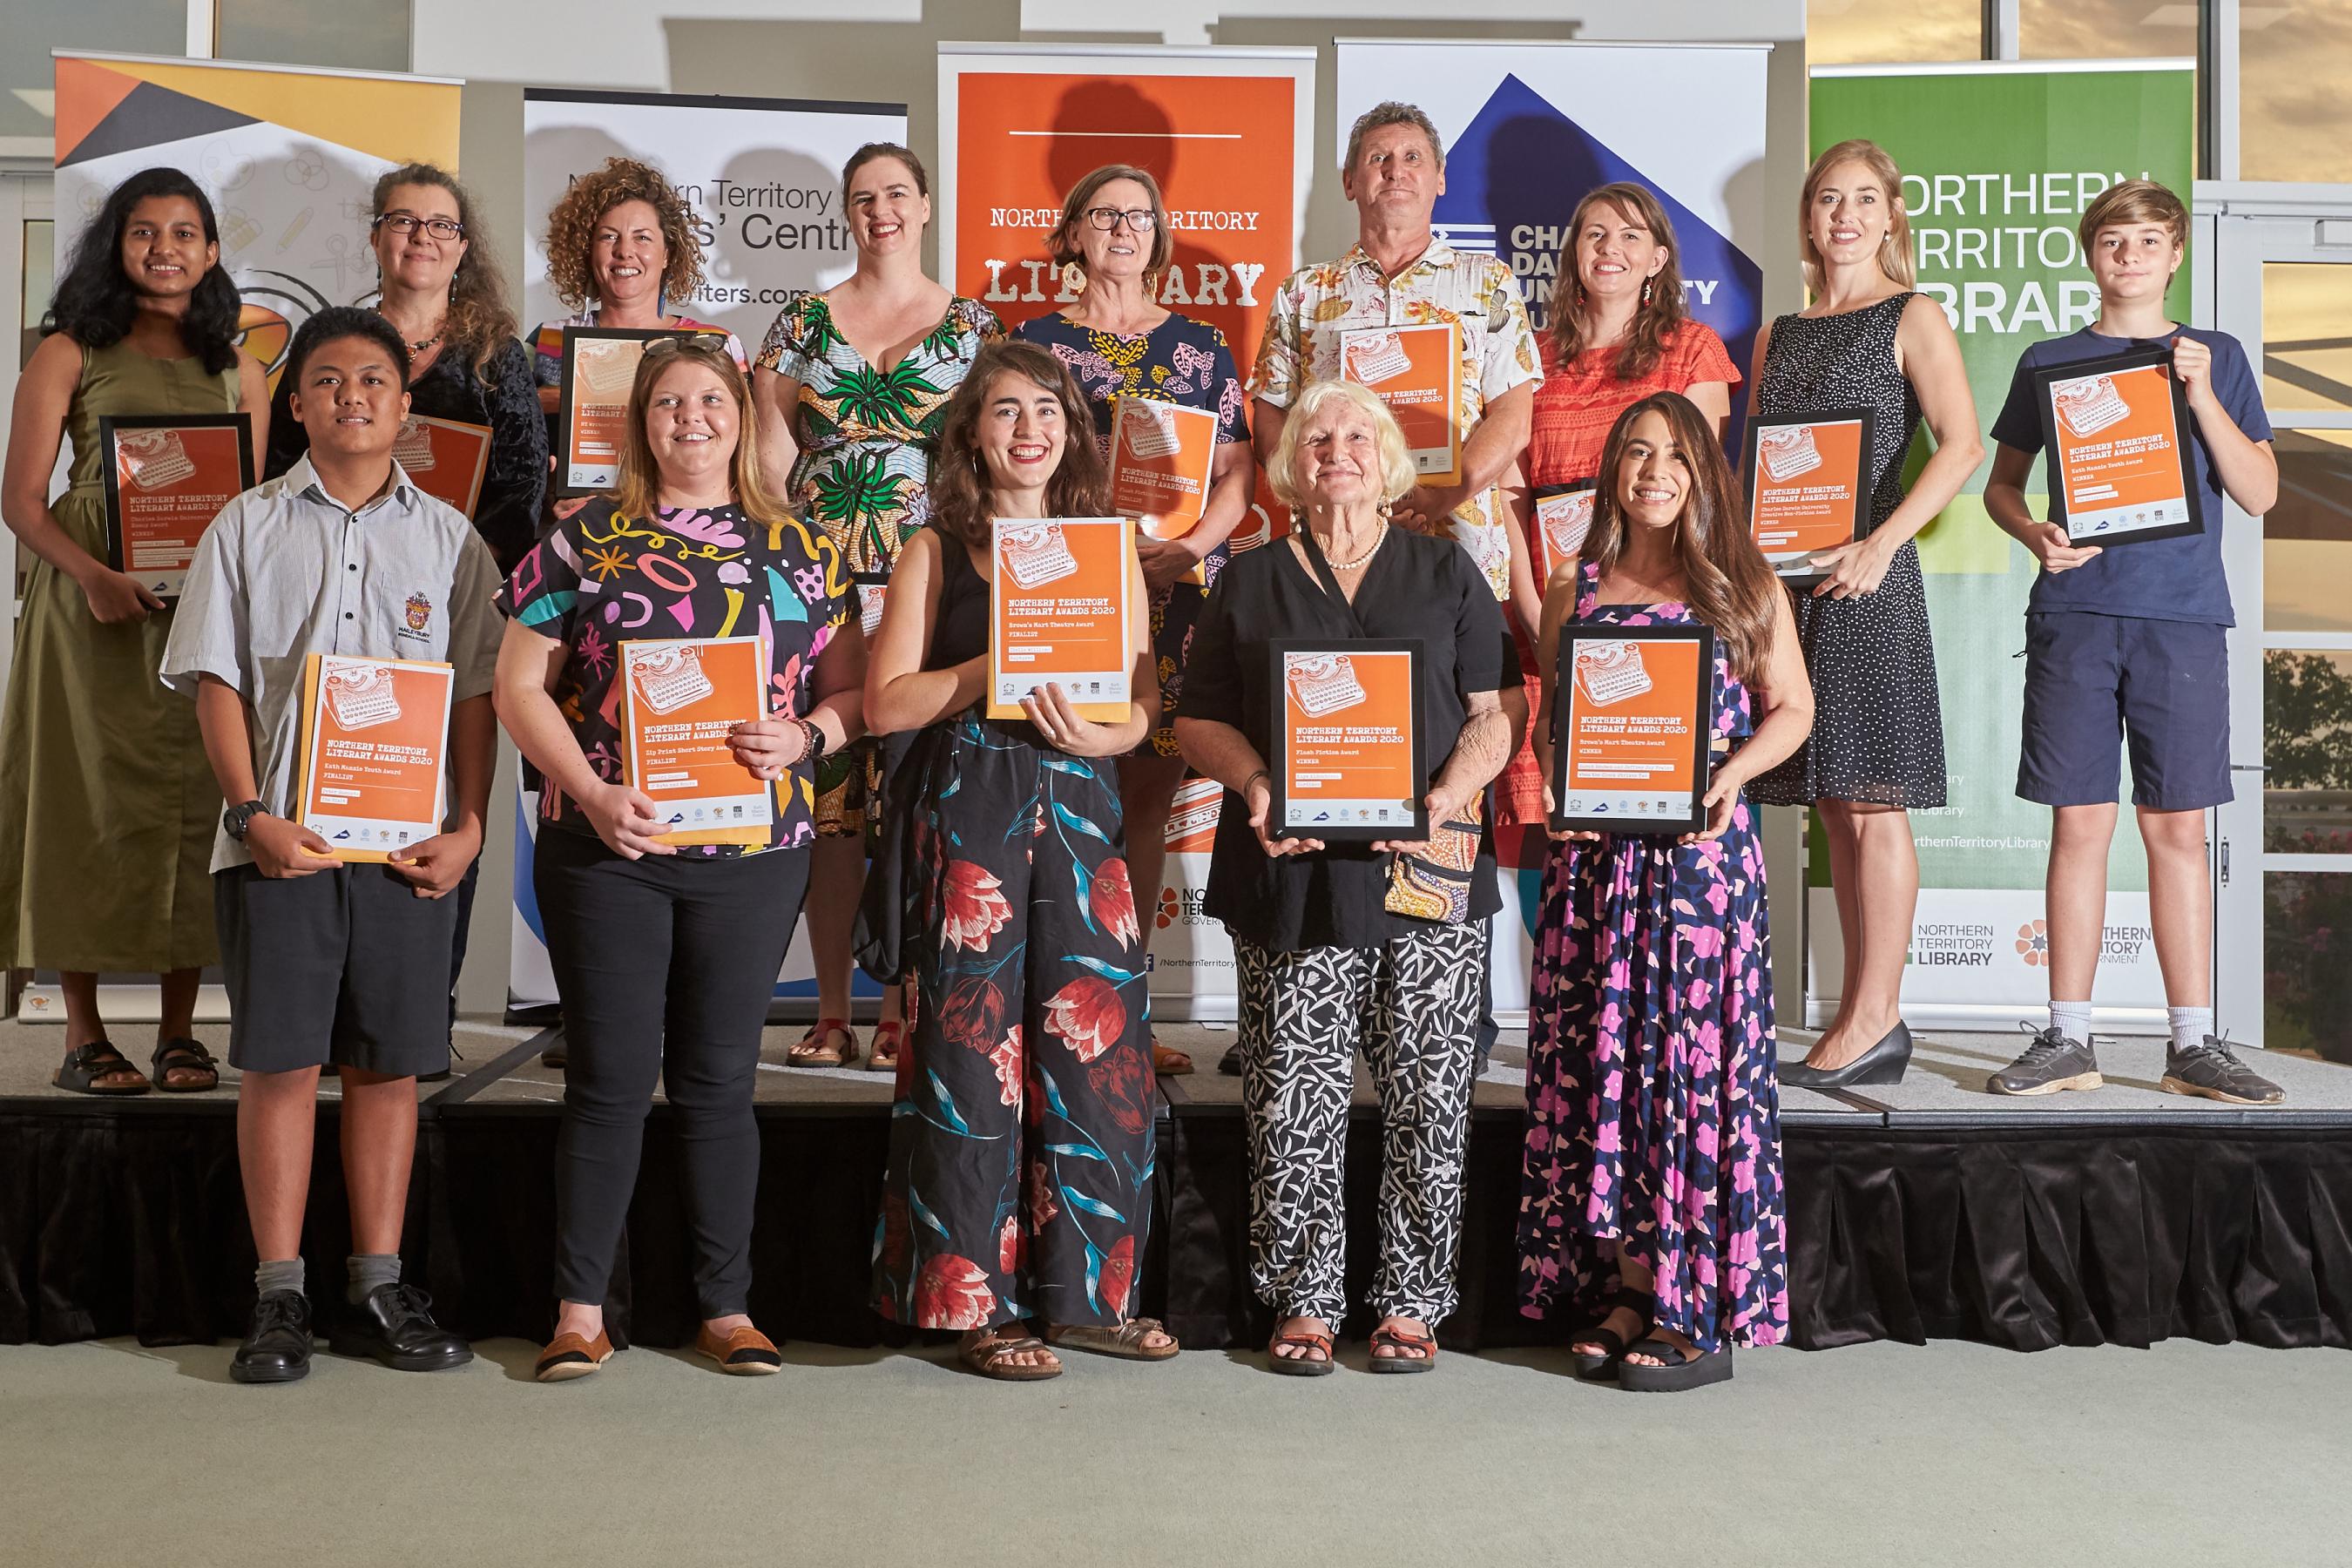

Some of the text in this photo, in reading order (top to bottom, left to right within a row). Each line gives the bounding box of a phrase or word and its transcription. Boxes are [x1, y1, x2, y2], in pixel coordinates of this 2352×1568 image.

[712, 179, 832, 215] Territory
[741, 213, 852, 252] Centr
[1911, 226, 2087, 269] RRITO
[984, 259, 1265, 307] LITARY
[1916, 280, 2100, 333] BRAR
[1394, 389, 1438, 398] TERRITORY
[2069, 434, 2163, 456] NORTHERN TERRITORY
[2070, 441, 2170, 463] LITERARY AWARDS 2020
[1121, 467, 1199, 487] NORTHERN TERRITORY
[1120, 475, 1200, 495] LITERARY AWARDS 2020
[1763, 485, 1845, 497] NORTHERN TERRITORY
[129, 494, 228, 504] NORTHERN TERRITORY
[177, 503, 210, 511] AWARDS
[1008, 598, 1109, 607] NORTHERN TERRITORY
[1009, 607, 1053, 616] LITERARY
[1056, 606, 1090, 615] AWARDS
[1581, 716, 1627, 725] NORTHERN
[644, 723, 692, 734] NORTHERN
[645, 732, 690, 743] LITERARY
[693, 729, 727, 740] AWARDS
[1295, 735, 1342, 744] LITERARY
[327, 740, 428, 756] NORTHERN TERRITORY
[326, 749, 433, 766] LITERARY AWARDS 2020
[646, 757, 677, 766] FINALIST
[1914, 836, 2051, 851] rthernTerritoryLibrary
[1918, 924, 1993, 937] NORTHERN
[2104, 927, 2152, 941] THERN
[1918, 937, 1993, 950] TERRITORY
[1918, 951, 1993, 966] LIBRARY
